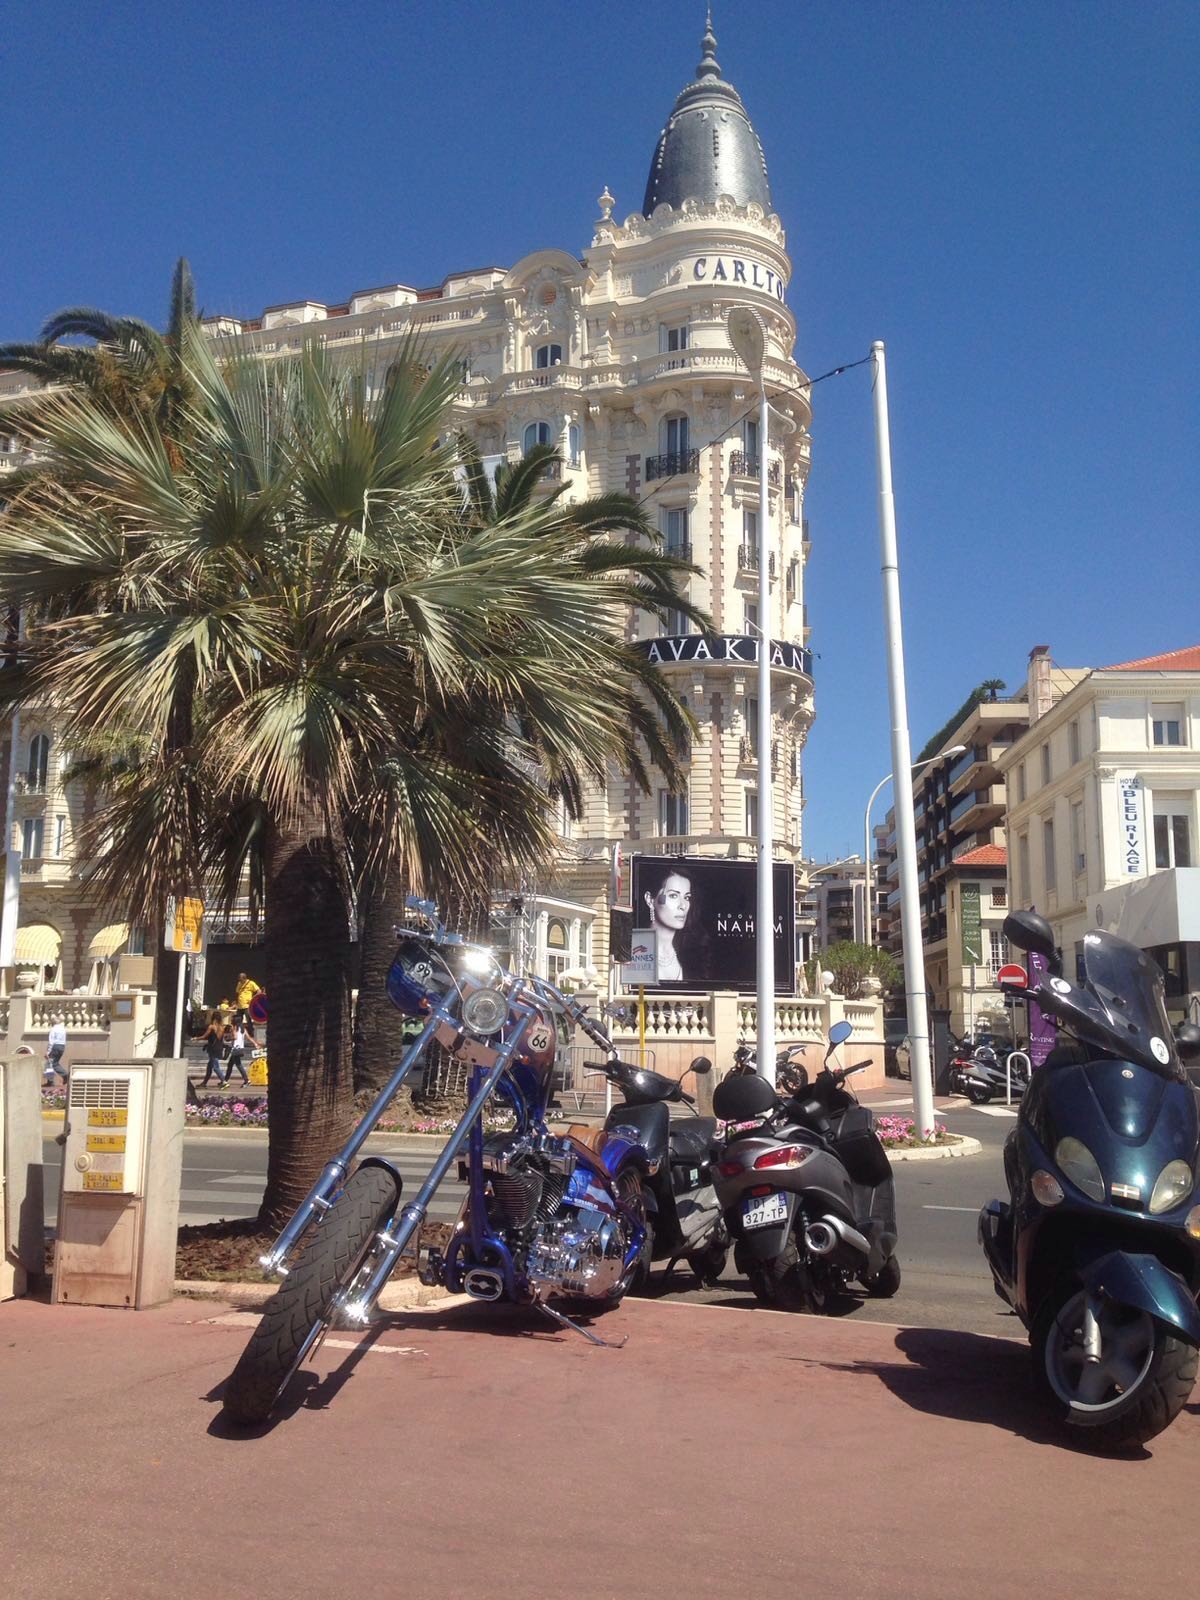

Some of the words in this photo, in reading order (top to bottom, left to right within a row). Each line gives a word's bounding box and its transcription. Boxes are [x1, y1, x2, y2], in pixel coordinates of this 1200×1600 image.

[717, 920, 783, 934] NAHM
[532, 1034, 547, 1049] 66
[745, 1208, 784, 1225] 327-TP
